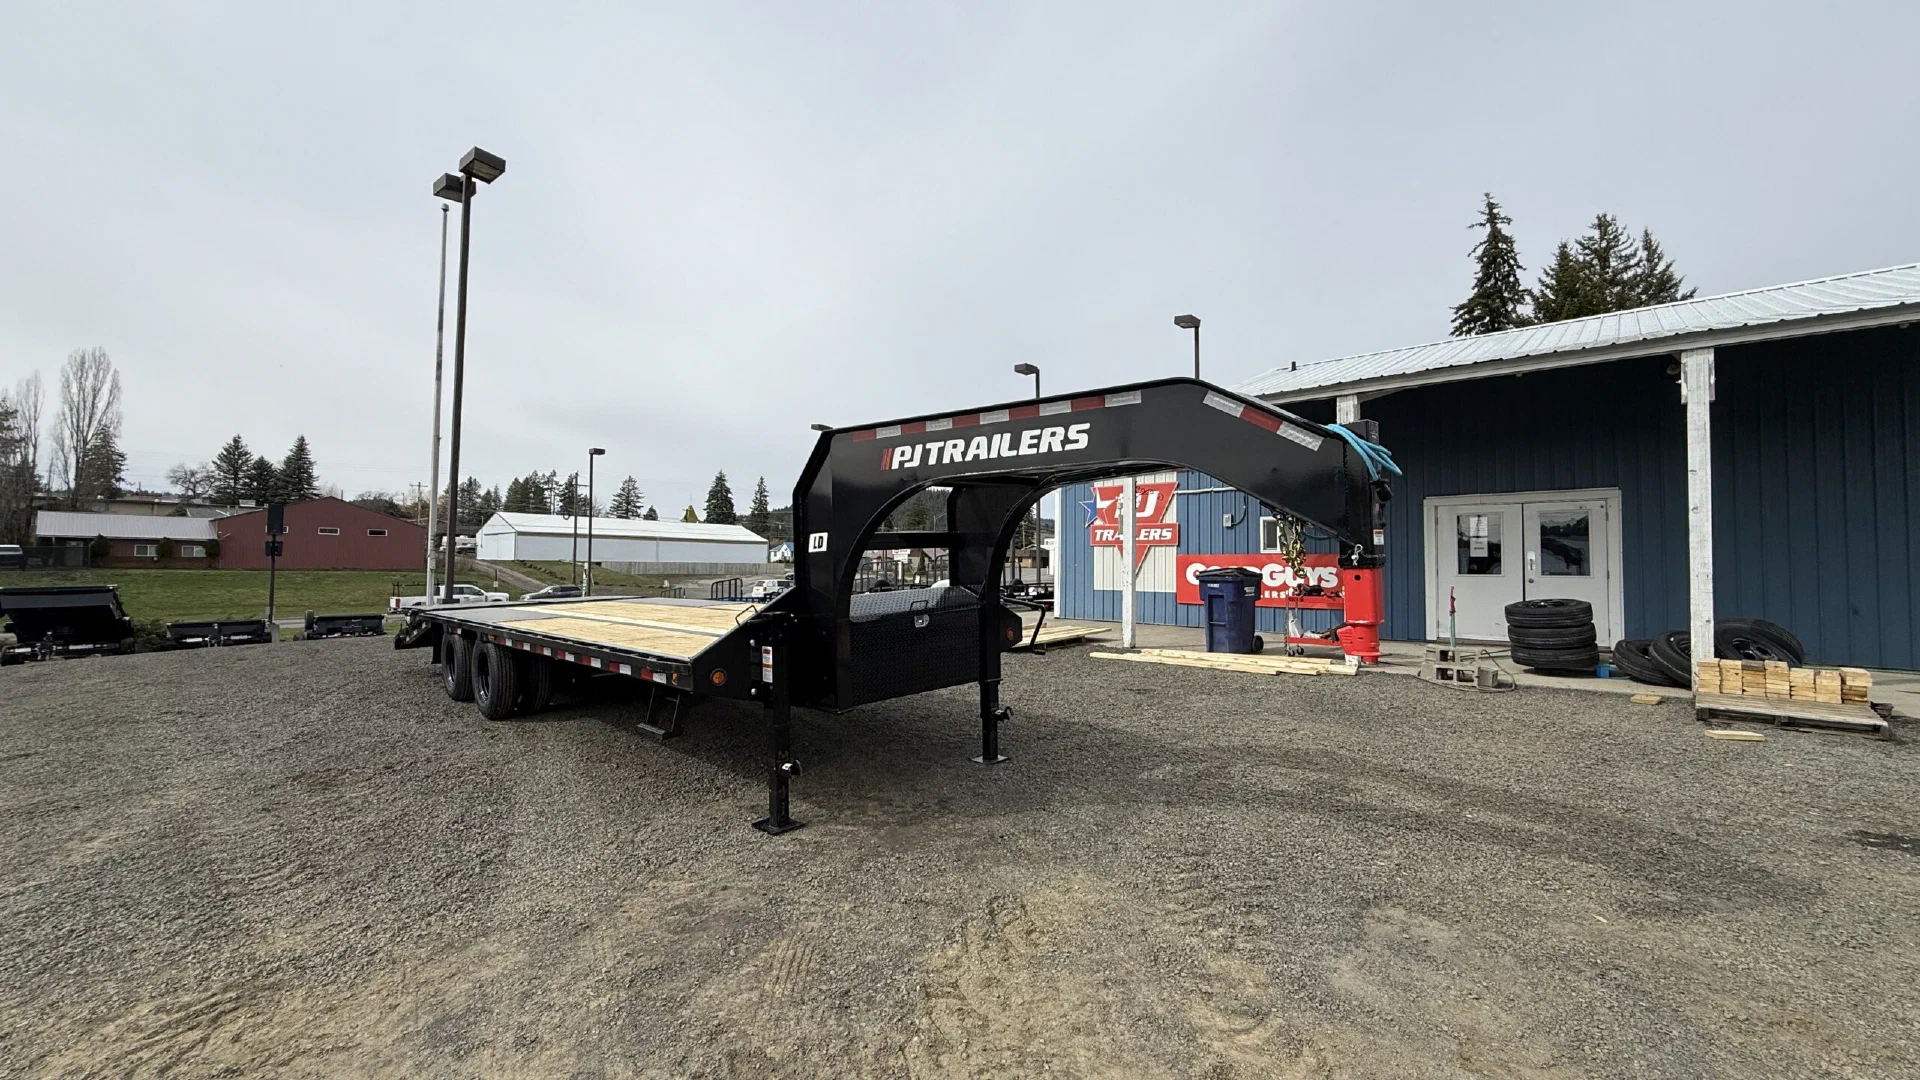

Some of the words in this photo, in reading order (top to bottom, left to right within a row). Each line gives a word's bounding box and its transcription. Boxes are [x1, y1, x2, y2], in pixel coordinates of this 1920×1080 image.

[891, 444, 923, 469] PJ
[926, 422, 1091, 466] TRAILERS
[1094, 528, 1172, 541] TRAERS
[813, 535, 824, 549] LD
